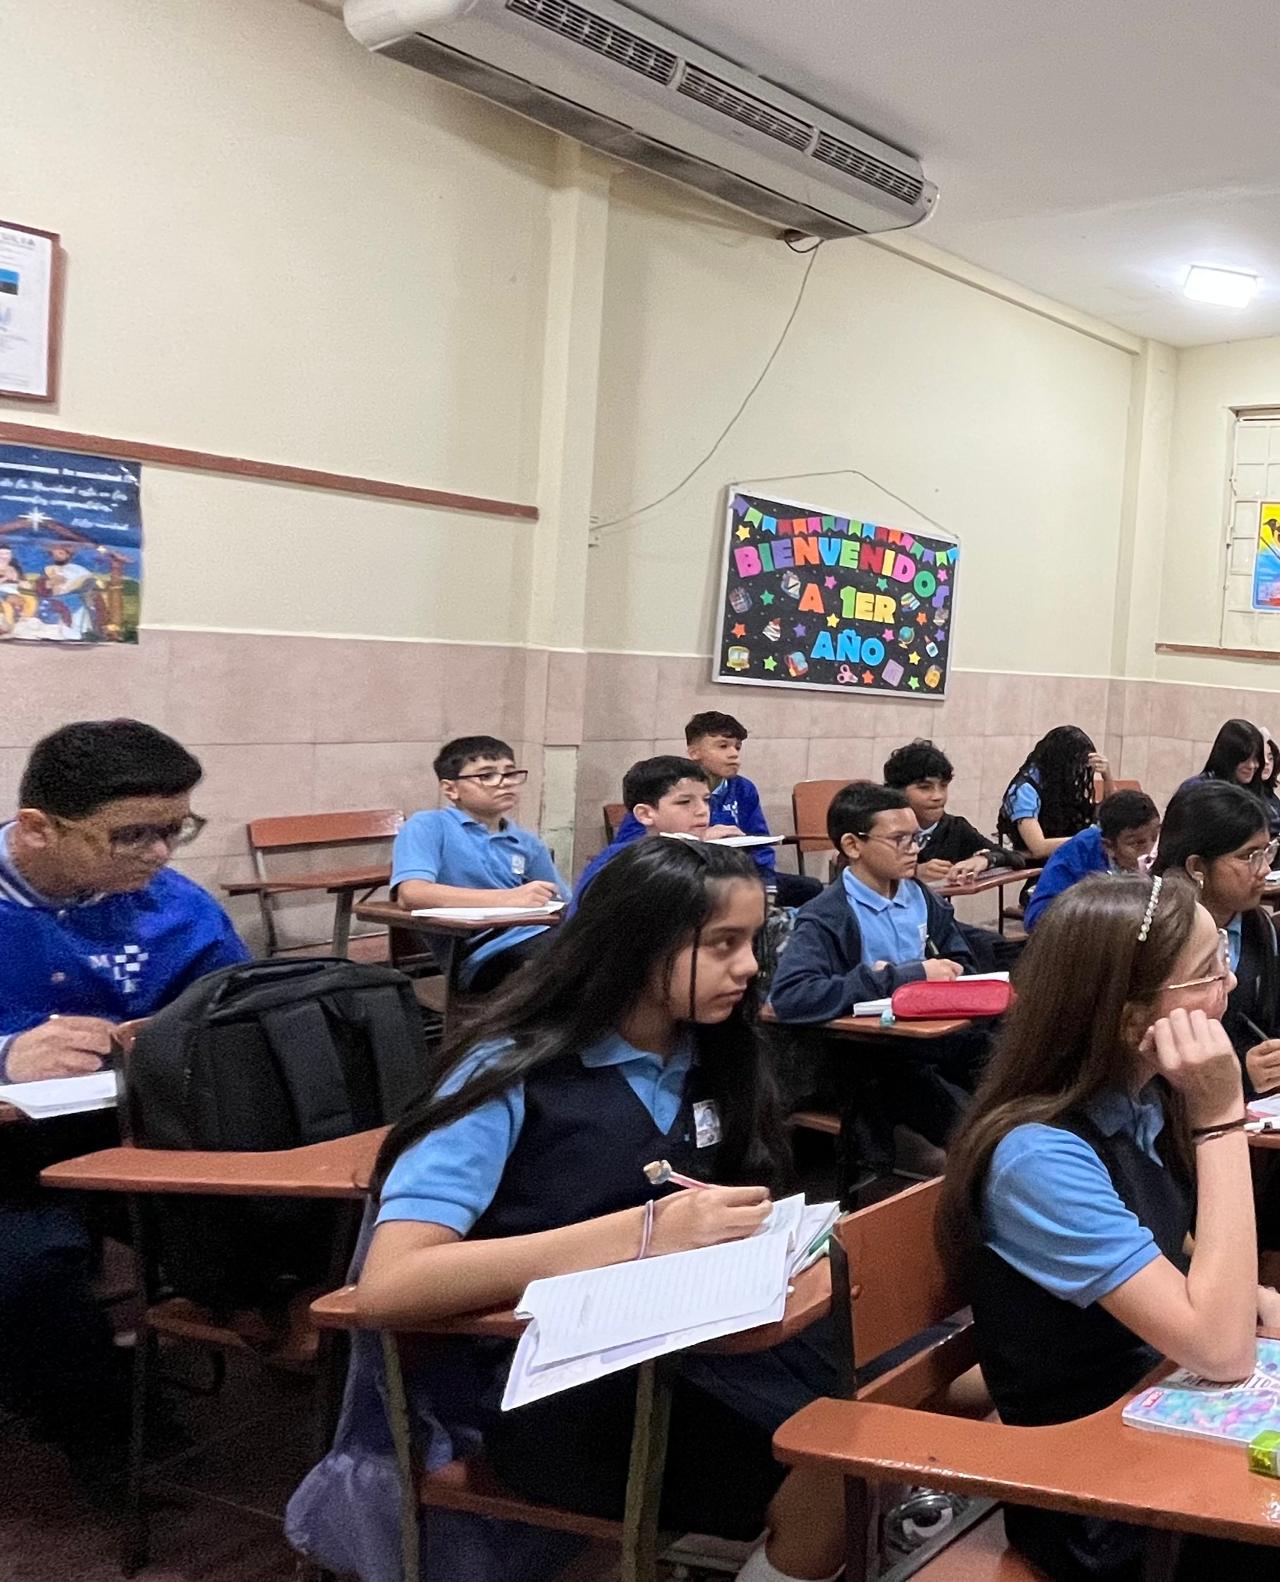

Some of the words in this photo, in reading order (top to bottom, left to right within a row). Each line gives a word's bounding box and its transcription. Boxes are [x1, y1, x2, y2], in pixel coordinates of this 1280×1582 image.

[733, 536, 936, 598] BIENVENIDO
[798, 583, 825, 614] A
[839, 585, 896, 624] 1ER
[810, 628, 885, 666] AÑO
